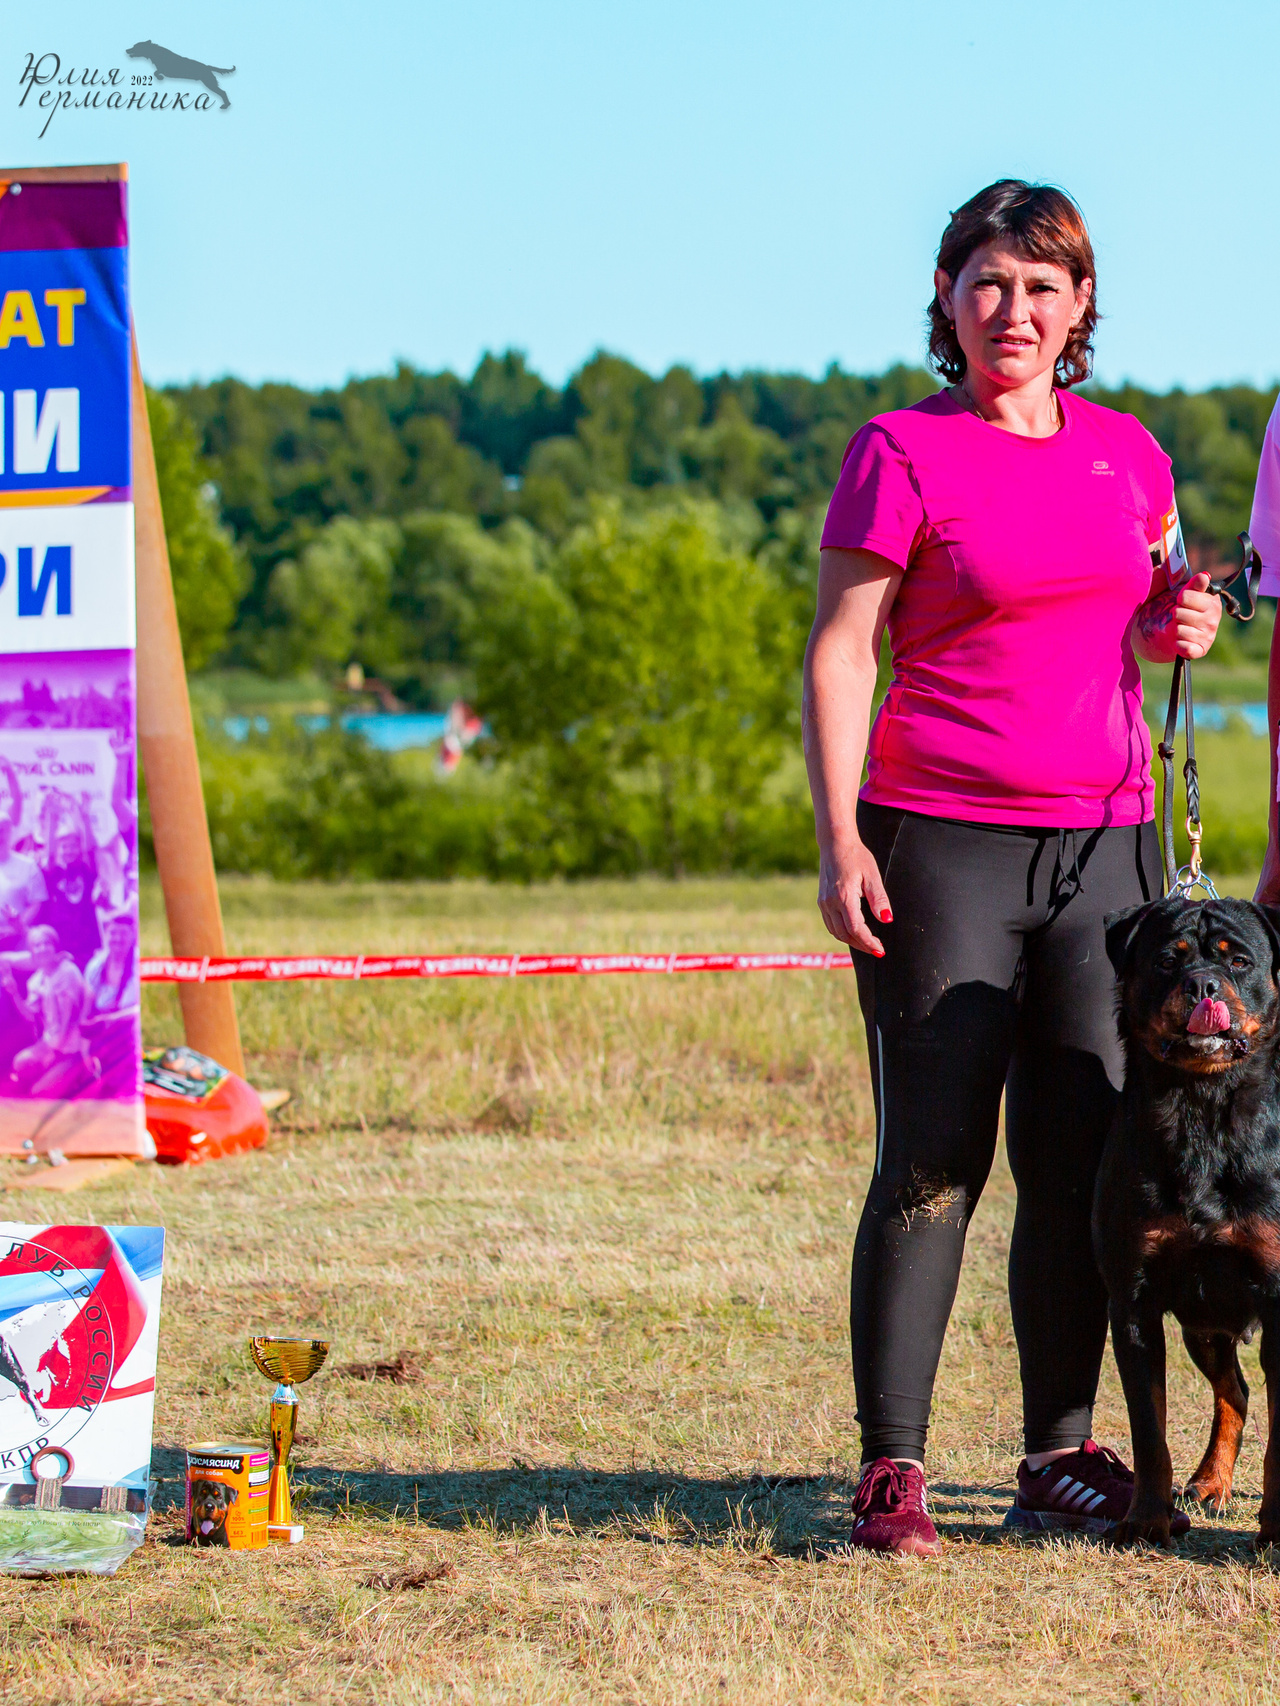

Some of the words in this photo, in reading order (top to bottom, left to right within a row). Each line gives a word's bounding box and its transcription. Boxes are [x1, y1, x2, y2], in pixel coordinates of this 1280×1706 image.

[0, 387, 80, 475] И
[0, 545, 72, 617] И
[48, 762, 95, 776] CANIN
[73, 1284, 109, 1413] РОССИИ
[205, 1469, 224, 1477] собак
